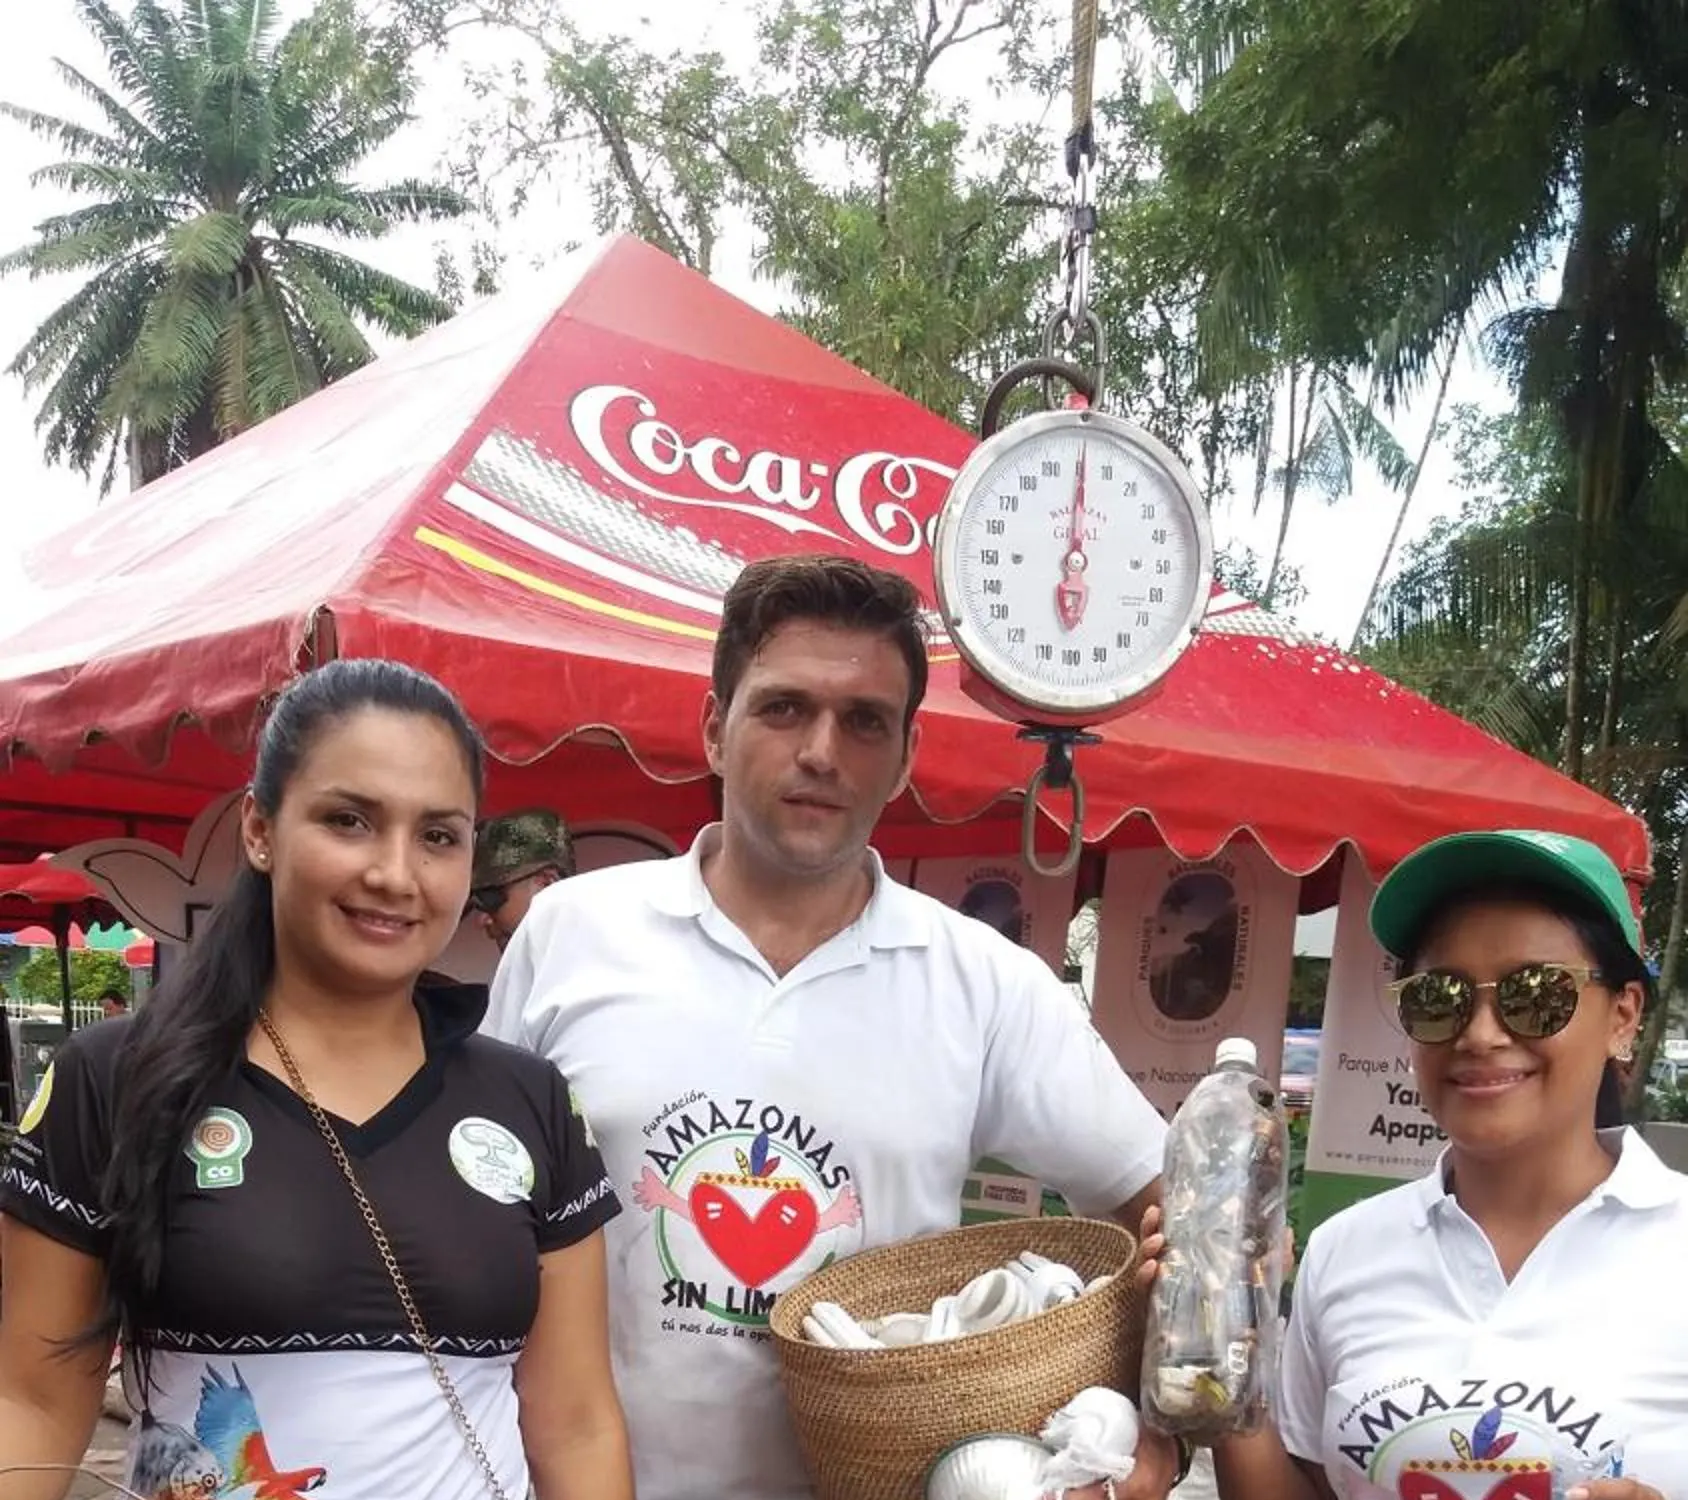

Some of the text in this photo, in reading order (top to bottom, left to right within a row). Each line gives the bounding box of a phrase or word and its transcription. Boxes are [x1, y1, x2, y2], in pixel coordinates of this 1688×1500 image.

[568, 384, 962, 555] Coca-C
[1101, 465, 1113, 480] 10
[1019, 475, 1037, 491] 180
[1123, 481, 1136, 497] 20
[1000, 496, 1018, 512] 170
[1142, 504, 1155, 519] 30
[986, 520, 1004, 536] 160
[1152, 529, 1166, 544] 40
[981, 550, 999, 566] 150
[1156, 560, 1171, 575] 50
[983, 580, 1002, 595] 140
[1149, 588, 1163, 603] 60
[990, 604, 1009, 619] 130
[1135, 611, 1149, 627] 70
[1007, 628, 1025, 643] 120
[1117, 633, 1131, 648] 80
[1035, 644, 1053, 661] 110
[1061, 650, 1081, 667] 100
[1092, 647, 1107, 664] 90
[1337, 1053, 1389, 1078] Parque
[645, 1099, 850, 1189] AMAZONAS
[661, 1277, 778, 1316] SIN LIM
[661, 1318, 675, 1331] tú
[679, 1322, 701, 1335] nos
[733, 1325, 745, 1338] la
